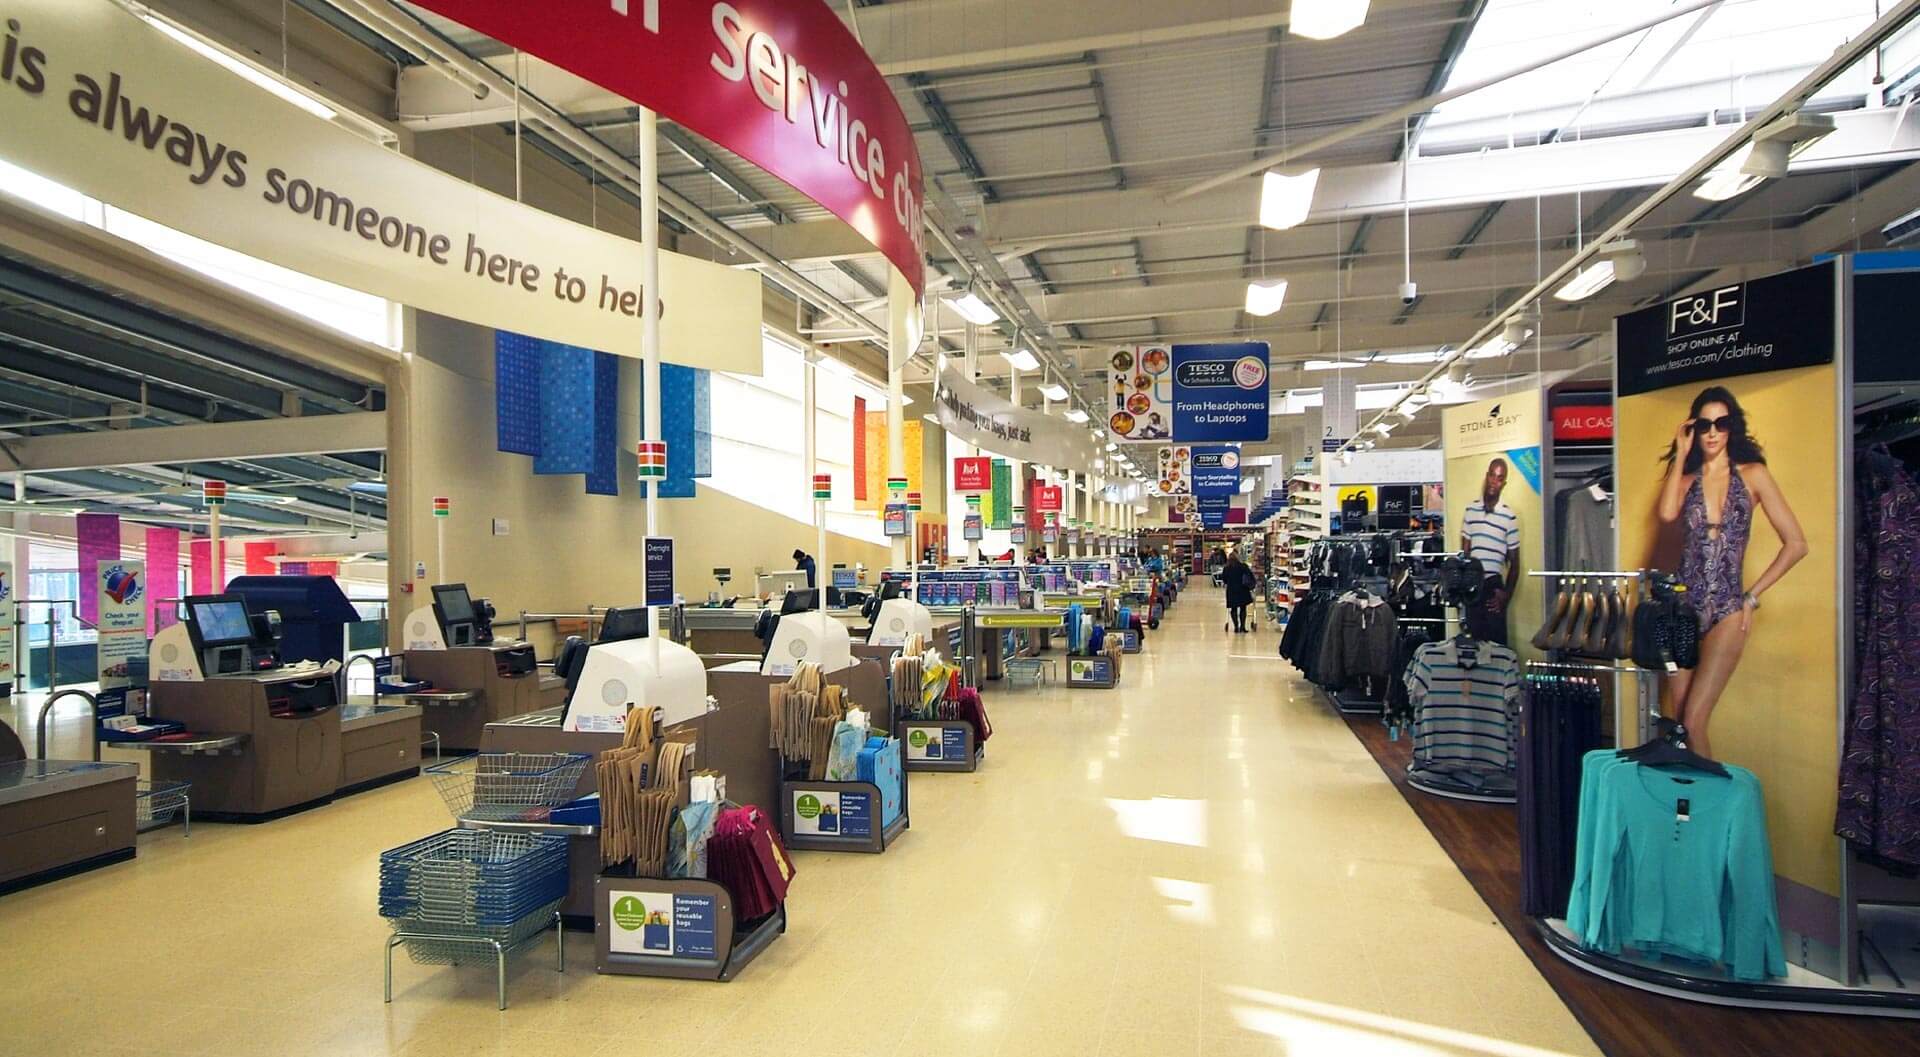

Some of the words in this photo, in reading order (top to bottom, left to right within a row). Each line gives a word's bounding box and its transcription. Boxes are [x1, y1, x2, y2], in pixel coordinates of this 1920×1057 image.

[710, 1, 886, 200] service
[1, 18, 47, 95] is
[69, 72, 248, 188] always
[263, 167, 451, 265] someone
[464, 233, 540, 292] here
[554, 267, 586, 304] to
[1671, 286, 1740, 334] F&F
[1667, 342, 1688, 355] SHOP
[1689, 334, 1725, 350] ONLINE
[1727, 332, 1741, 342] AT
[1646, 343, 1774, 375] www.tesco.com/clothing
[1188, 364, 1225, 374] TESCO
[1176, 402, 1202, 411] From
[1203, 401, 1265, 412] Headphones
[1195, 414, 1206, 423] to
[1207, 414, 1247, 424] Laptops
[1460, 419, 1493, 433] STONE
[1497, 415, 1517, 426] BAY
[1562, 417, 1583, 429] ALL
[1586, 416, 1613, 428] CAS
[1326, 426, 1333, 437] 2
[102, 565, 123, 580] PRICE
[124, 586, 144, 606] CHECK
[804, 797, 810, 806] 1
[625, 899, 632, 912] 1
[676, 898, 709, 906] Remember
[676, 912, 703, 920] reusable
